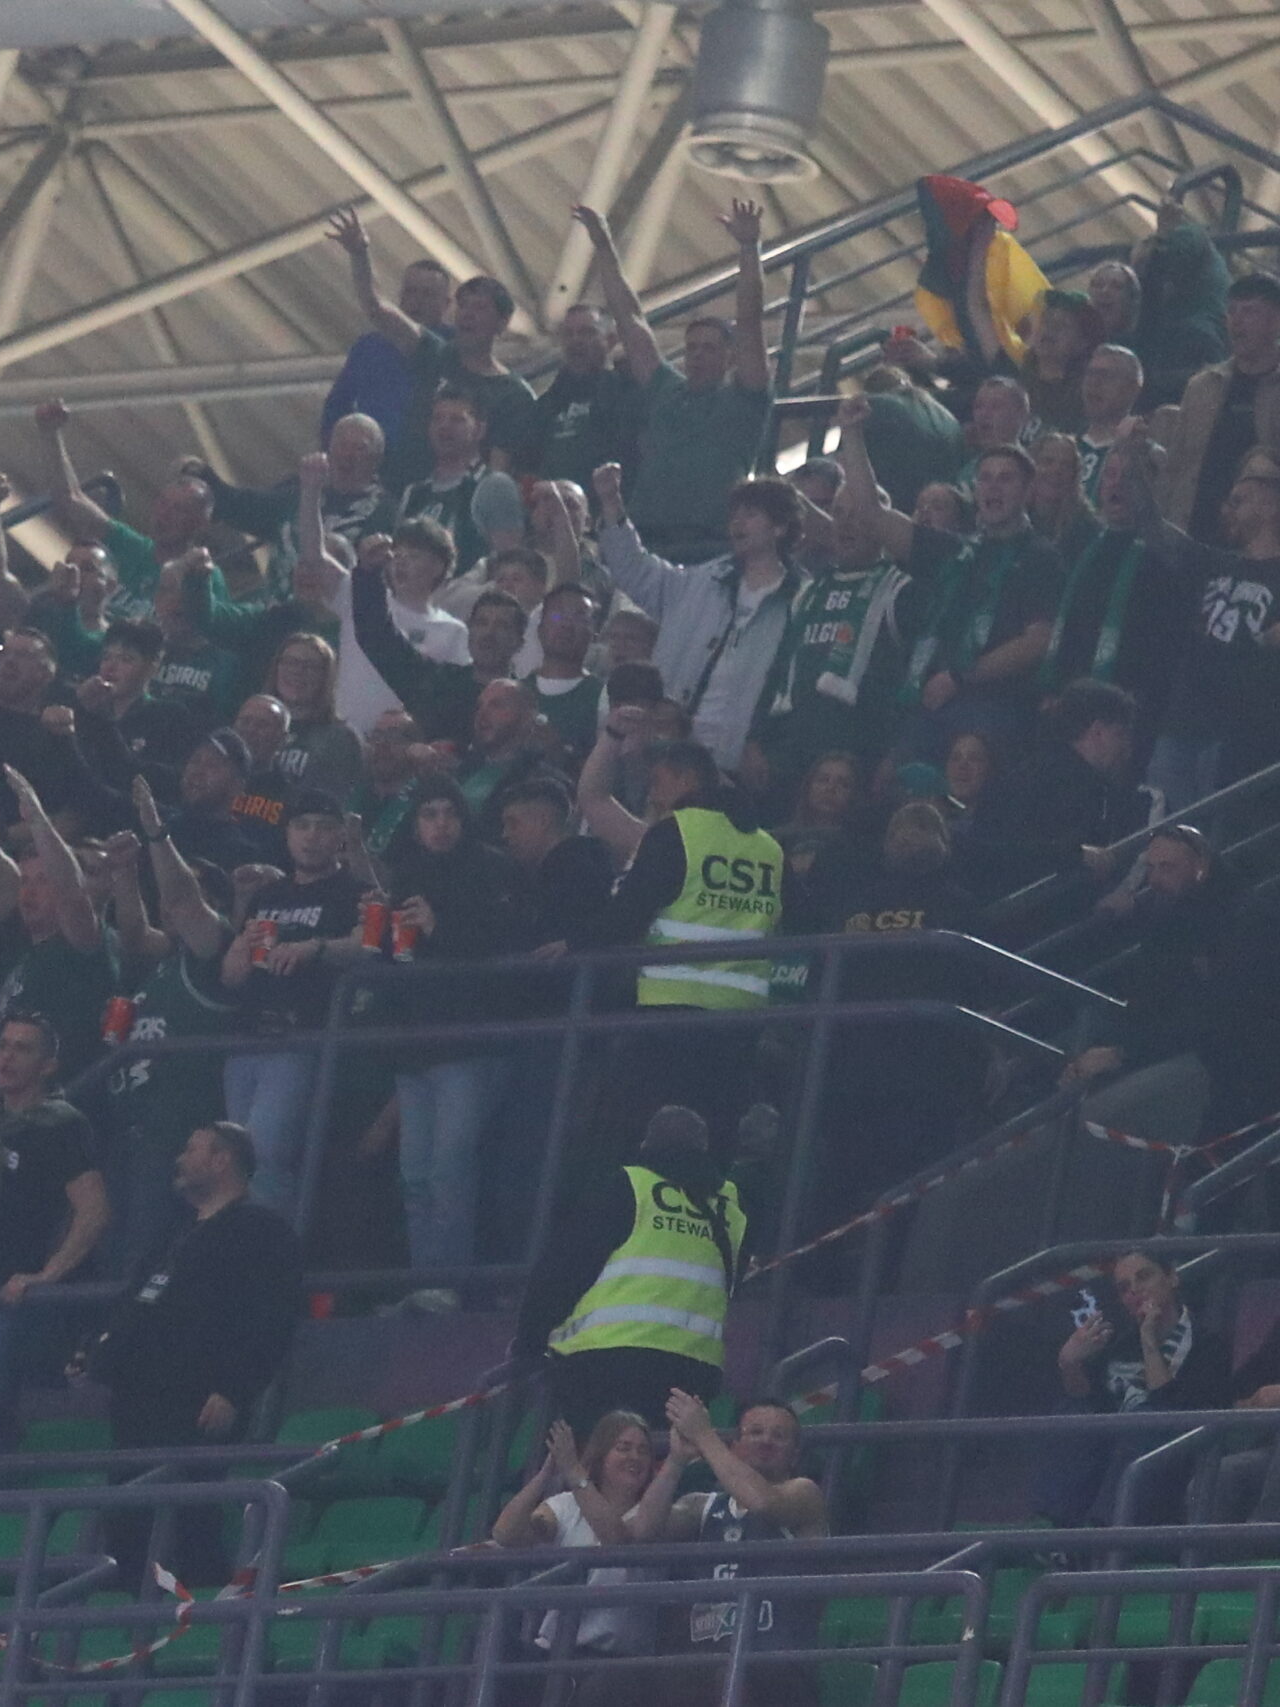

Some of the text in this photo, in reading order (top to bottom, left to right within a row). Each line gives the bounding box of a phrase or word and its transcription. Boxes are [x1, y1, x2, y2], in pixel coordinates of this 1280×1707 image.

[701, 854, 775, 898] CSI
[697, 891, 775, 916] STEWARD
[875, 910, 926, 930] CSI
[652, 1216, 712, 1239] STEWA
